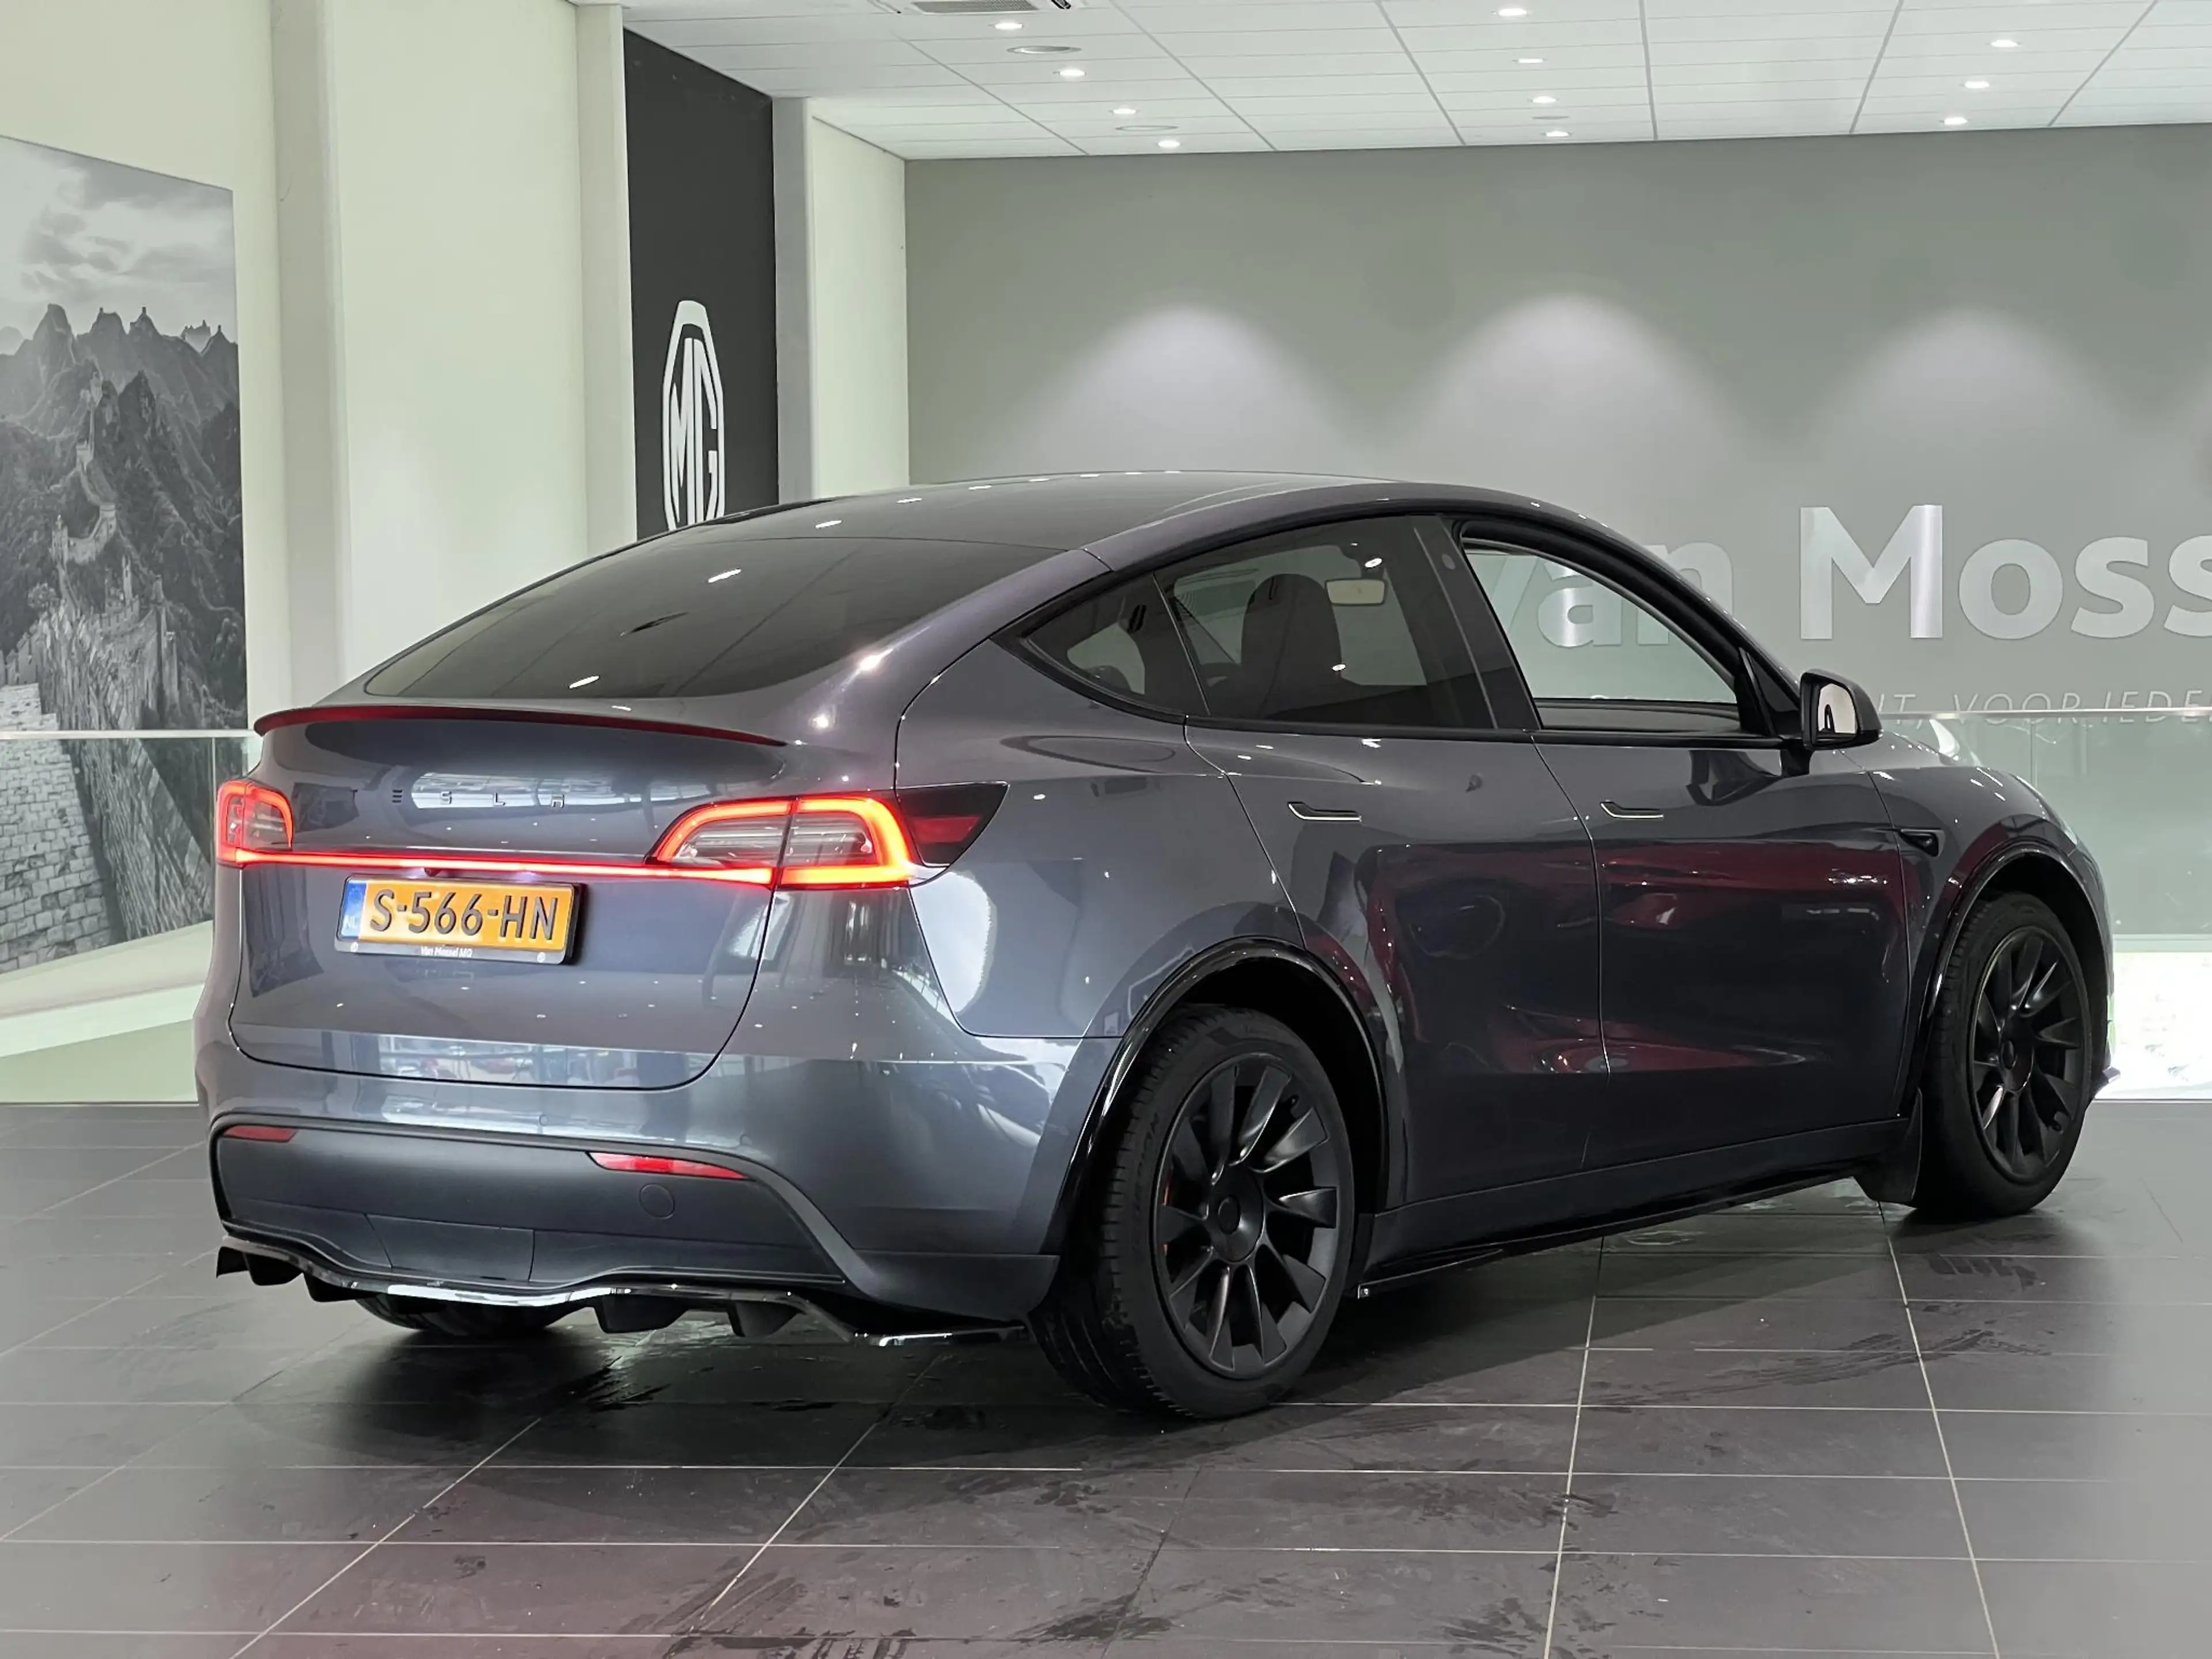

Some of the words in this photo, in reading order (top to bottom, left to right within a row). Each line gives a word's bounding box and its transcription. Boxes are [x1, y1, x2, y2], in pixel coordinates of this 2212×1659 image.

[670, 338, 718, 527] MG
[1953, 692, 2081, 725] VOOR
[2102, 690, 2212, 725] IEDE
[345, 914, 358, 929] NL
[369, 888, 558, 940] S-566-HN
